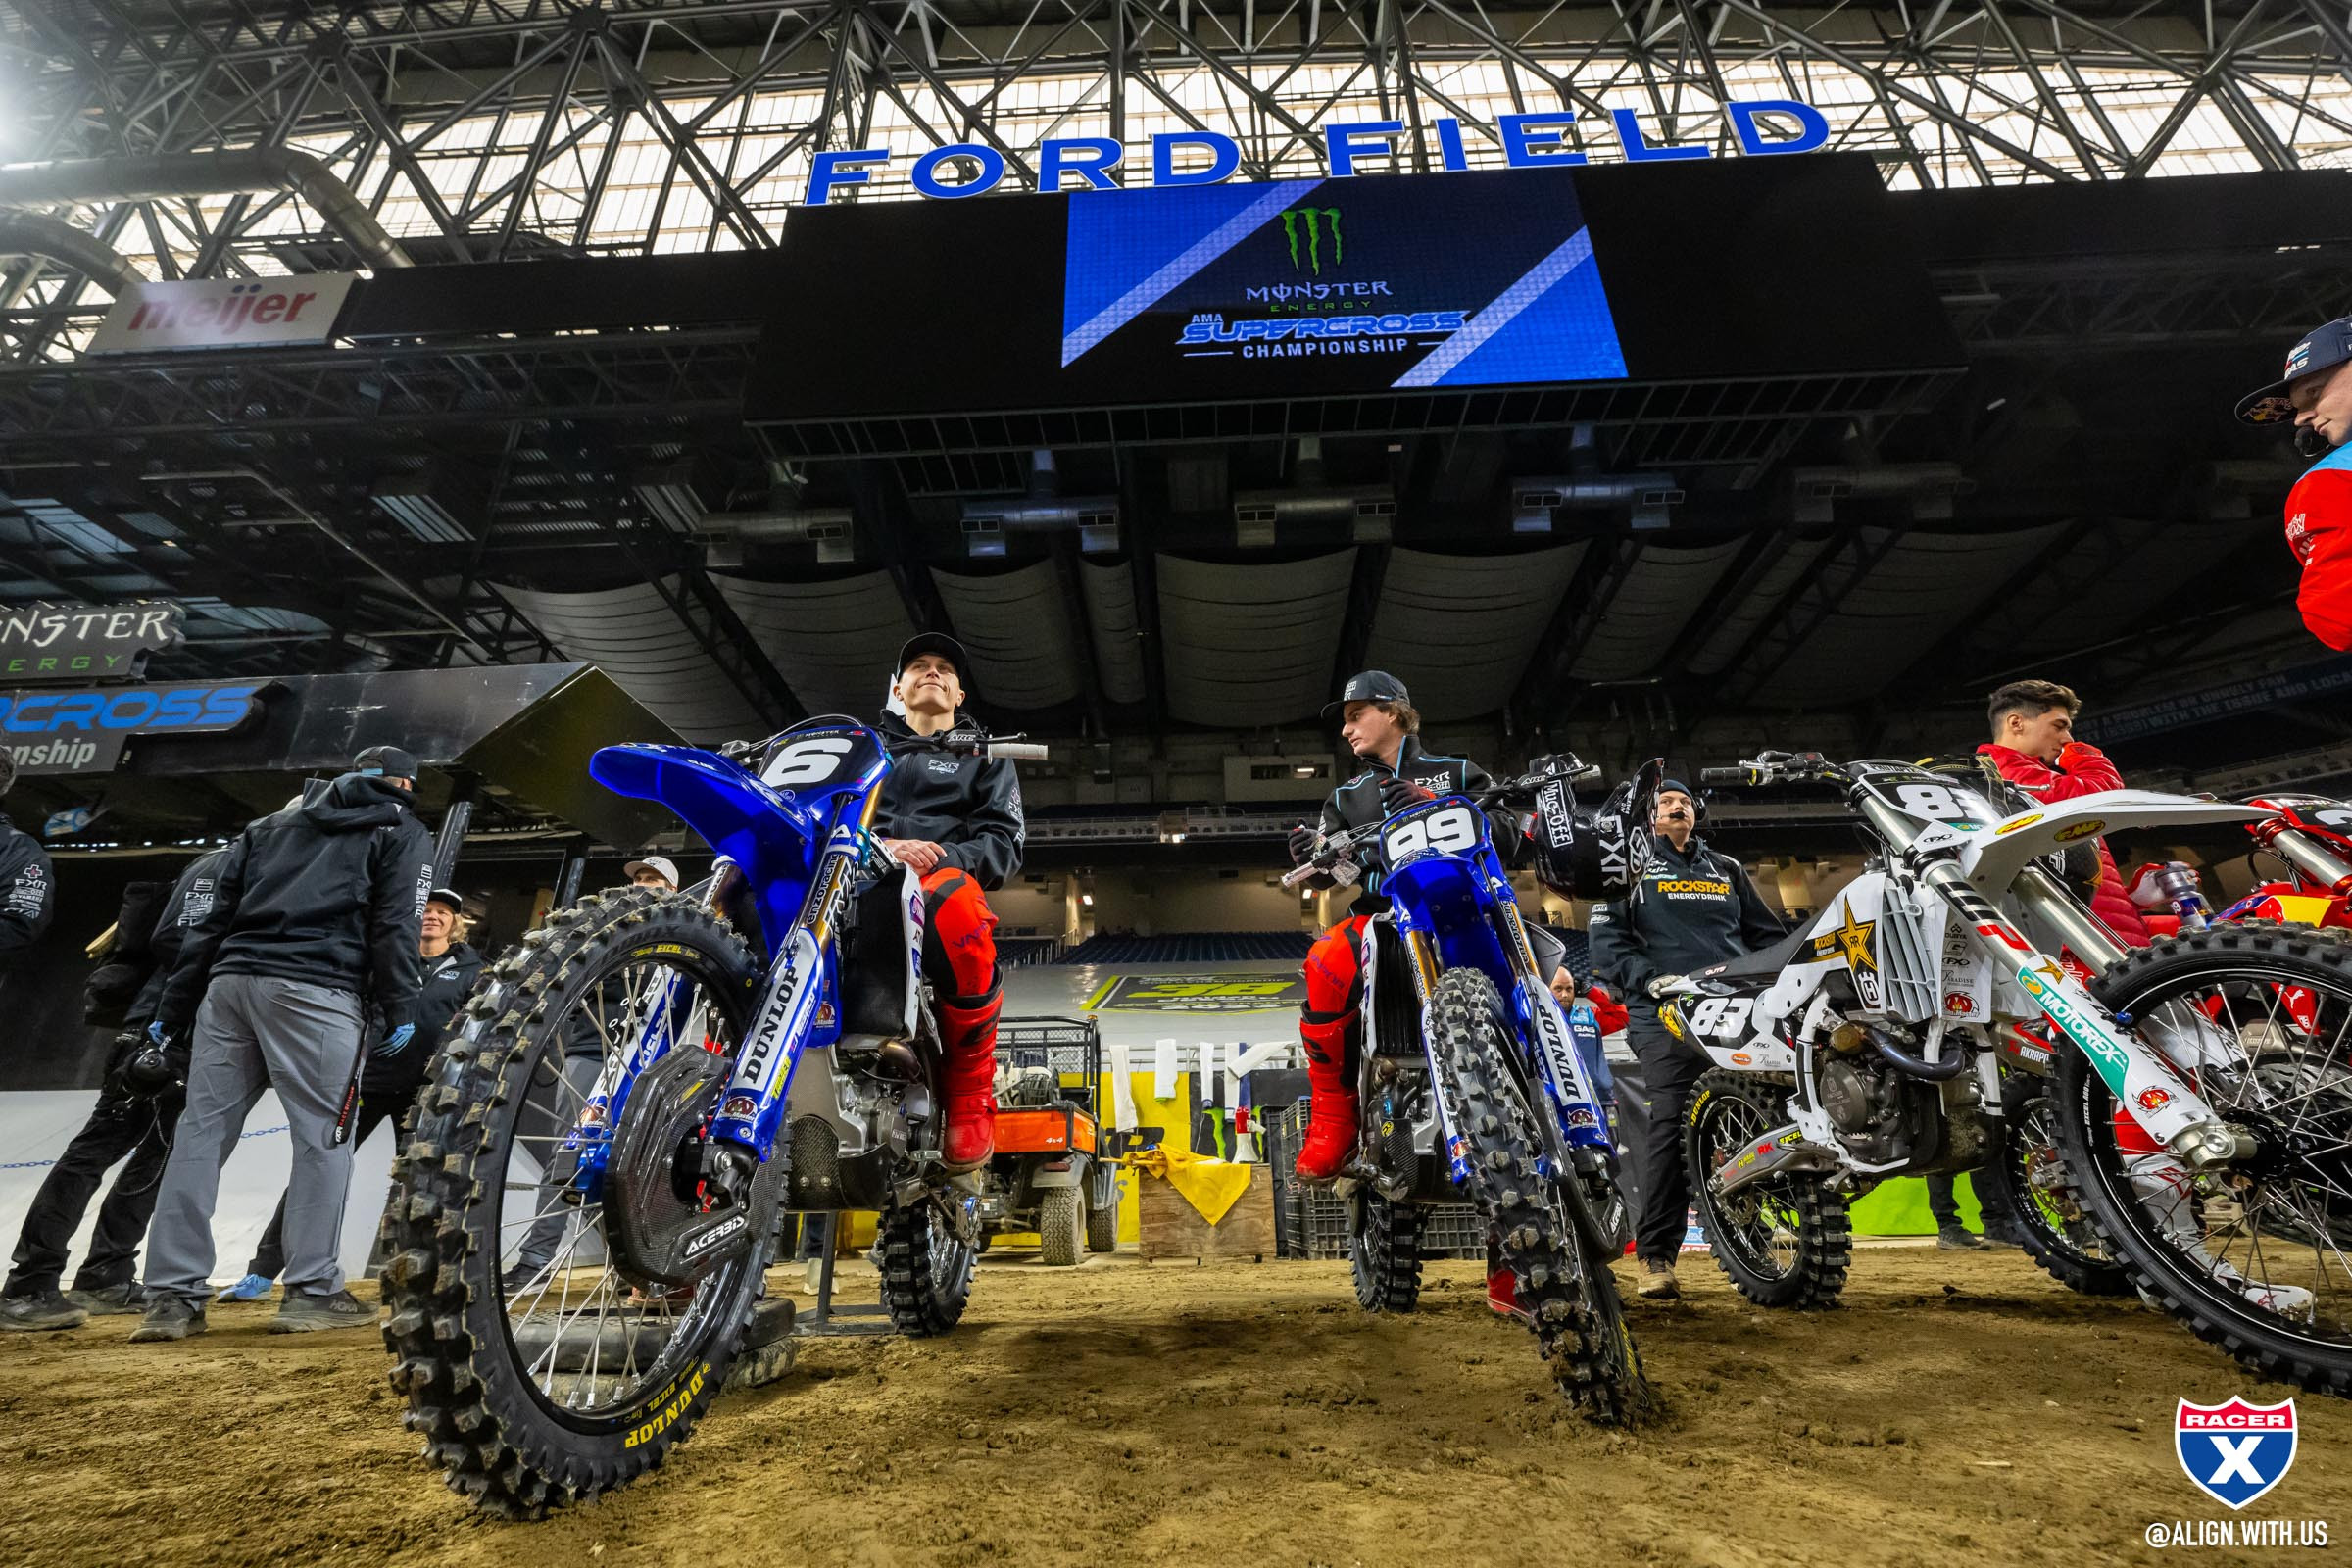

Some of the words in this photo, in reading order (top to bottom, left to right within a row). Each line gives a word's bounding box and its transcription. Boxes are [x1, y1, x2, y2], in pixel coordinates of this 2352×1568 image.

[803, 130, 1242, 206] FORD
[1321, 99, 1832, 178] FIELD
[1246, 281, 1394, 303] MONSTER
[1270, 300, 1372, 313] ENERGY
[128, 284, 317, 335] meijer
[1191, 313, 1224, 324] AMA
[1176, 310, 1471, 344] SUPERCROSS
[1242, 338, 1409, 359] CHAMPIONSHIP
[0, 610, 170, 648] NSTER
[8, 655, 122, 672] ERGY
[5, 738, 96, 769] nship
[760, 738, 853, 788] 6
[1414, 771, 1450, 786] FXR
[1544, 783, 1570, 846] Muc-Off
[1387, 808, 1476, 861] 99
[1599, 815, 1628, 886] FXR
[15, 878, 47, 890] FXR
[1657, 881, 1731, 895] ROCKSTAR
[655, 944, 682, 954] EXCEL
[1126, 982, 1297, 999] 38
[743, 963, 799, 1085] DUNLOP
[1573, 1024, 1596, 1033] GAS
[1690, 997, 1754, 1038] 83
[2039, 989, 2122, 1064] MOTOREX
[1538, 1005, 1582, 1100] DUNLOP
[1690, 1090, 1711, 1125] DUNLOP
[1757, 1142, 1774, 1155] RK
[686, 1214, 747, 1256] ACERBIS
[625, 1372, 706, 1449] DUNLOP
[647, 1382, 676, 1412] EXCEL
